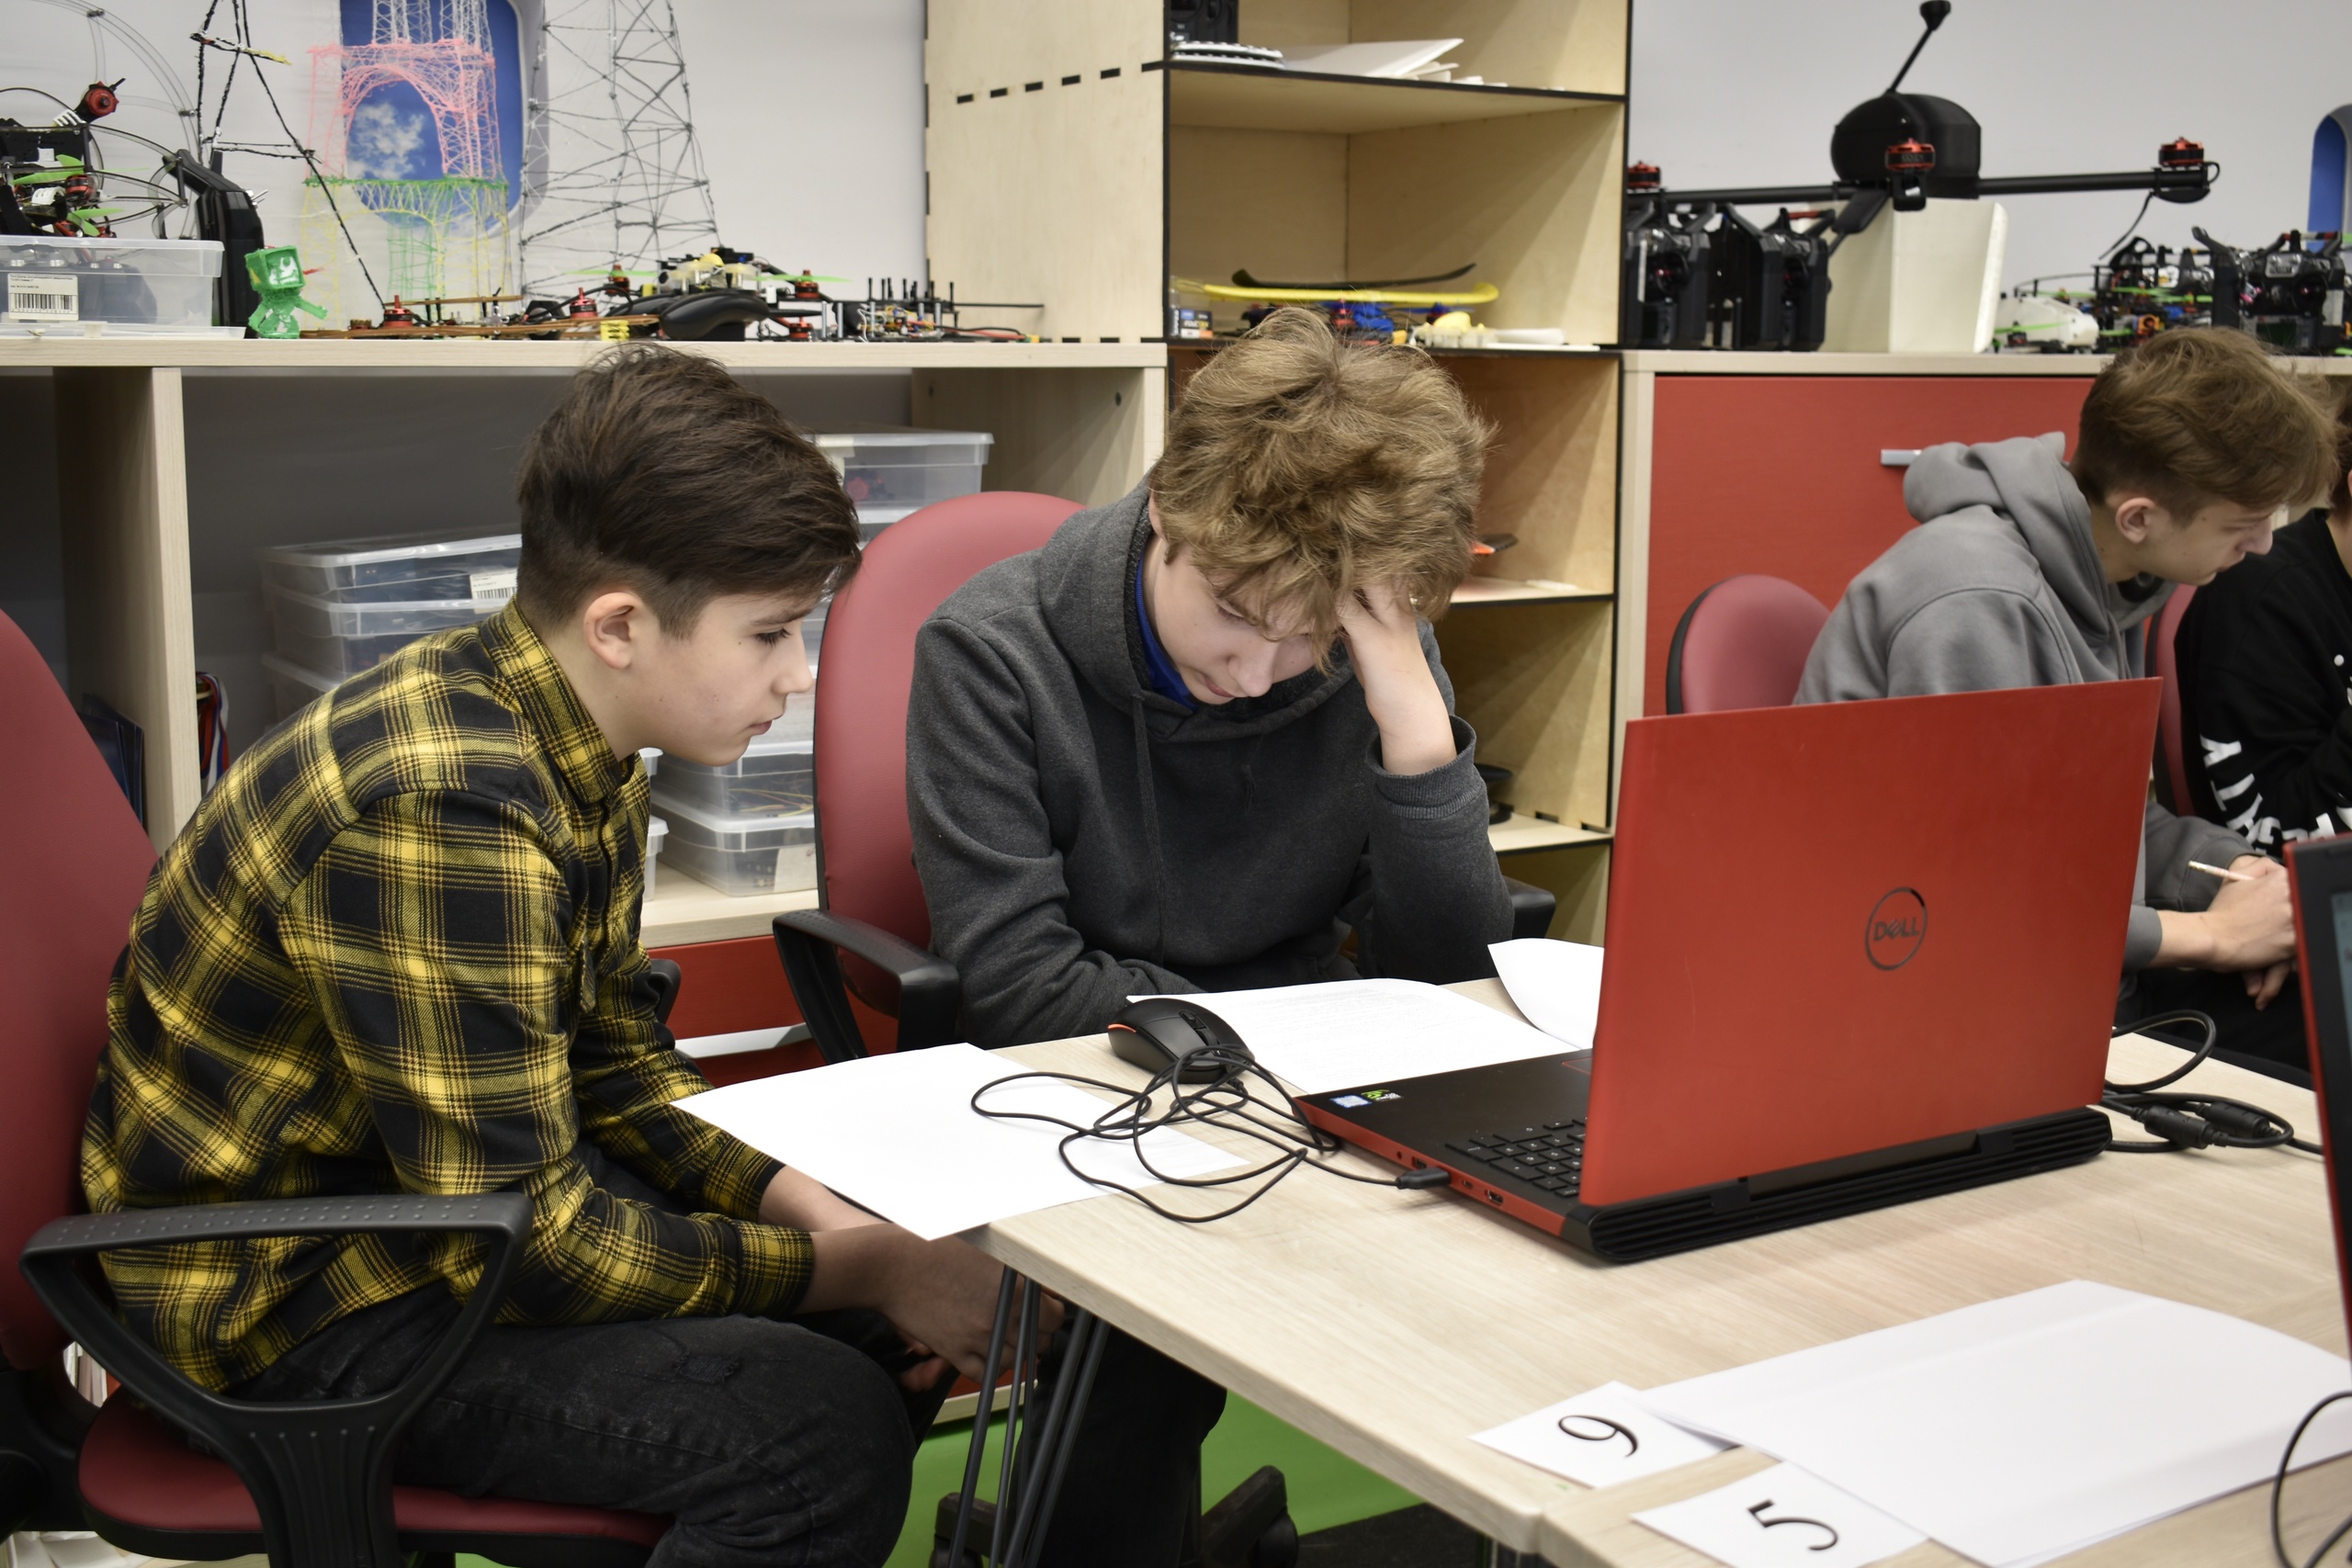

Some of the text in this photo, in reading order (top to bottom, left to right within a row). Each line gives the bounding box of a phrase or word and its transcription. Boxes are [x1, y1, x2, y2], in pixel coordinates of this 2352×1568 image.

[1873, 917, 1919, 942] DELL
[1557, 1415, 1638, 1458] 9
[1747, 1499, 1838, 1551] 5
